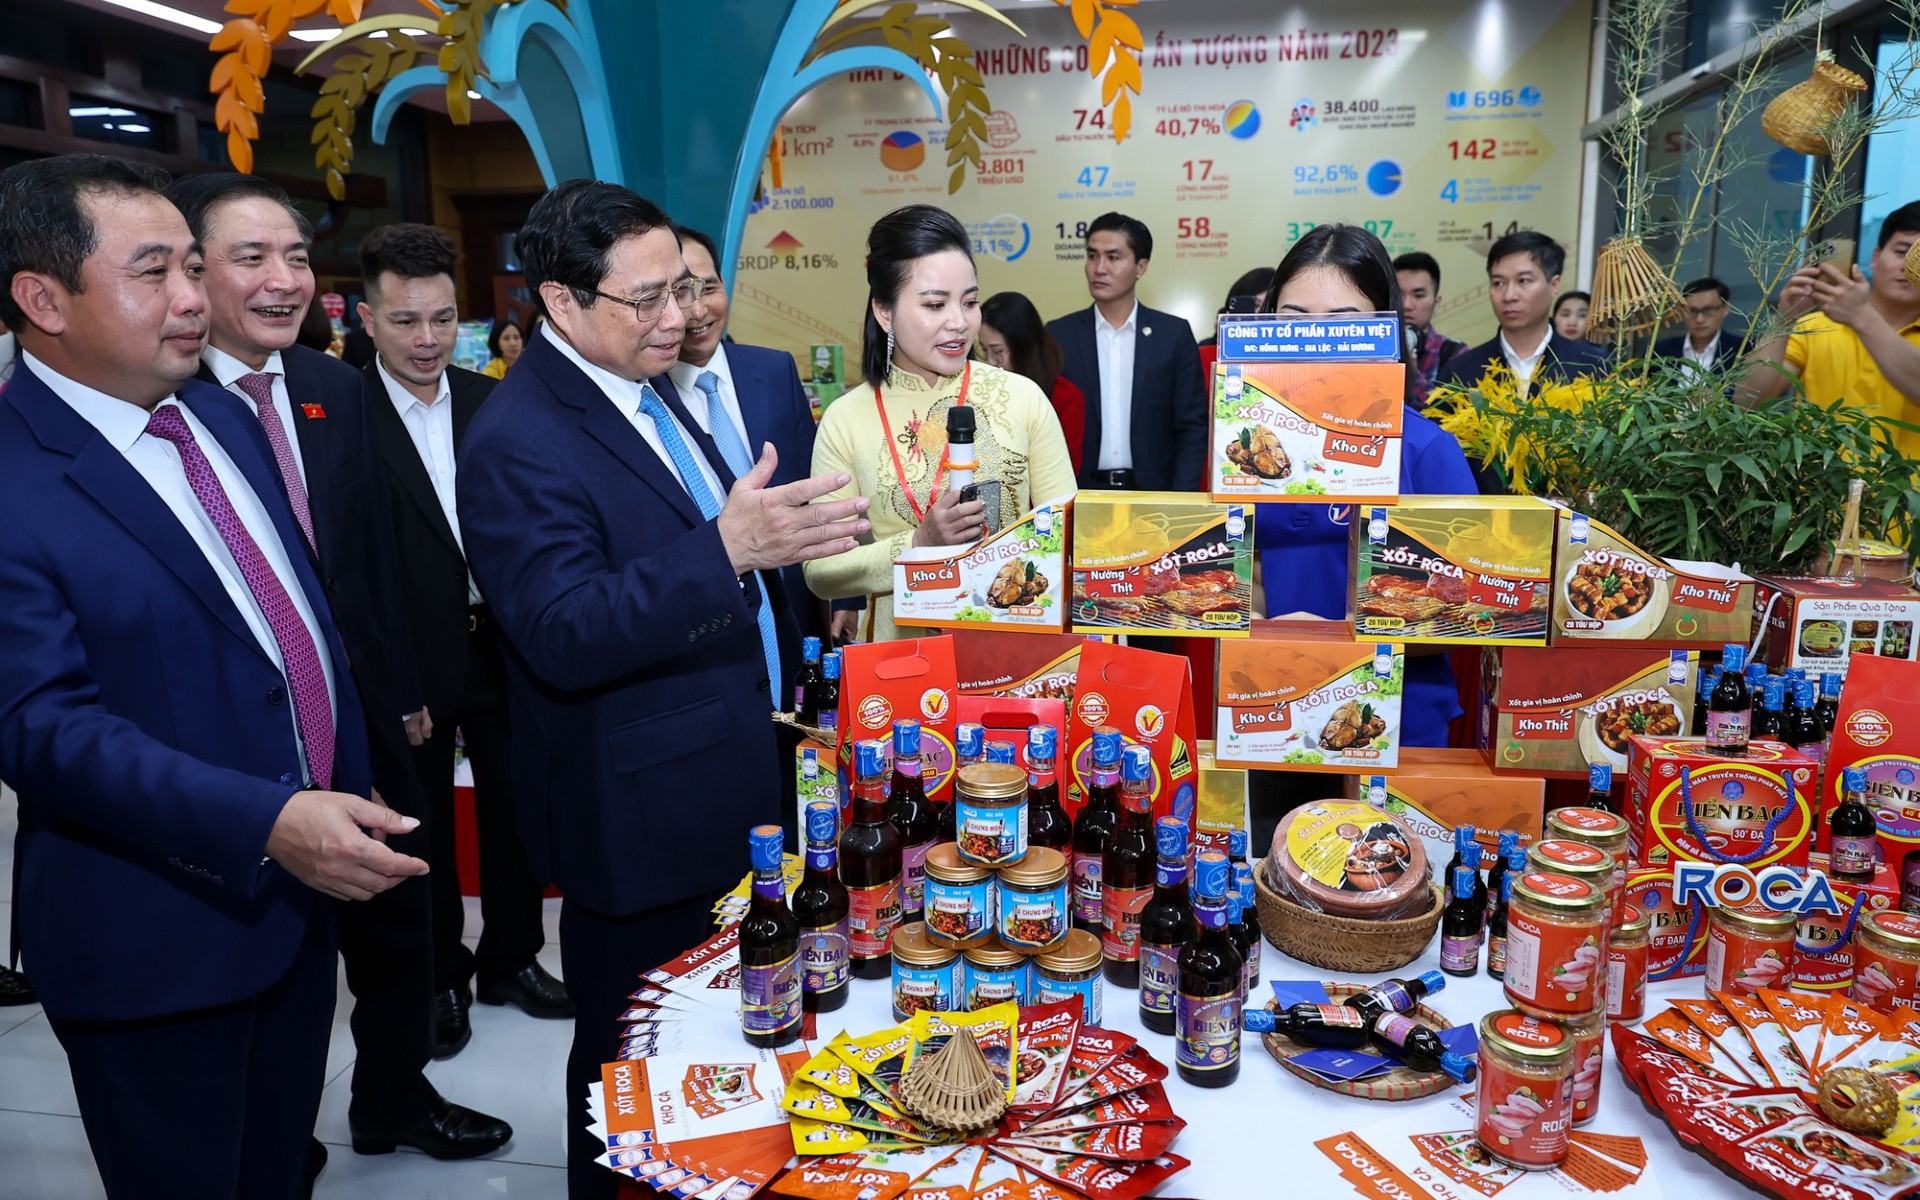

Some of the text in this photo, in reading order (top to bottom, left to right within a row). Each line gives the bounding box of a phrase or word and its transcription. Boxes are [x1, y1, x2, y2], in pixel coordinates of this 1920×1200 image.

[975, 44, 1051, 76] NHỮNG
[1061, 48, 1089, 73] CO
[1193, 36, 1268, 70] TƯỢNG
[1278, 28, 1329, 61] NĂM
[1341, 28, 1398, 57] 2023
[1323, 99, 1380, 115] 38.400
[1473, 89, 1514, 108] 696
[1073, 109, 1105, 130] 74
[1155, 117, 1221, 138] 40,7%
[1448, 138, 1497, 160] 142
[1077, 166, 1110, 187] 47
[1182, 160, 1214, 181] 17
[1293, 164, 1359, 184] 92,6%
[1440, 178, 1458, 204] 4
[772, 197, 834, 210] 2.100.000
[1177, 216, 1210, 239] 58
[785, 254, 838, 271] 8,16%
[1227, 322, 1392, 340] CÔNG TY CỔ PHẦN XUYÊN VIỆT
[1304, 343, 1317, 352] GIA
[1318, 342, 1331, 354] LỘC
[1237, 402, 1319, 436] XỐT ROCA
[1333, 415, 1346, 424] gia
[1346, 416, 1354, 426] vị
[1353, 417, 1372, 428] hoàn
[1331, 438, 1377, 457] Kho Cá
[964, 536, 1041, 570] XỐT ROCA
[1094, 556, 1104, 566] gia
[1105, 555, 1112, 564] vị
[1113, 551, 1130, 563] hoàn
[1150, 541, 1230, 576] XỐT ROCA
[1382, 546, 1465, 580] XỐT ROCA
[1481, 559, 1494, 570] gia
[1500, 563, 1520, 573] hoàn
[1583, 546, 1668, 581] XỐT ROCA
[912, 566, 954, 583] Kho Cá
[1090, 567, 1125, 583] Nướng
[1478, 573, 1516, 591] Nướng
[1111, 581, 1134, 595] Thịt
[1680, 584, 1732, 605] Kho Thịt
[1495, 592, 1519, 609] Thịt
[1860, 601, 1881, 612] Quà
[1884, 602, 1907, 613] Tặng
[961, 682, 971, 690] gia
[978, 678, 994, 688] hoàn
[1227, 692, 1240, 701] Xốt
[1240, 692, 1252, 702] gia
[1252, 691, 1259, 700] vị
[1259, 688, 1277, 699] hoàn
[1296, 680, 1379, 712] XỐT ROCA
[1508, 691, 1583, 708] Xốt gia vị hoàn chỉnh
[1583, 686, 1671, 719] XỐT ROCA
[863, 706, 885, 717] 100%
[1239, 710, 1285, 725] Kho Cá
[1519, 718, 1569, 734] Kho Thịt
[1853, 723, 1883, 731] 100%
[1675, 860, 1843, 916] ROCA
[1517, 919, 1542, 935] ROCA
[682, 946, 711, 965] XỐT
[1824, 953, 1850, 967] ĐẠM
[685, 964, 710, 980] KHO
[1032, 1011, 1073, 1031] ROCA
[1790, 1006, 1822, 1022] XỐT
[1050, 1032, 1069, 1043] Thịt
[1505, 1027, 1550, 1043] ROCA
[860, 1043, 886, 1064] XỐT
[615, 1064, 638, 1116] XỐT ROCA
[654, 1089, 675, 1125] KHO CÁ
[1333, 1140, 1380, 1178] ROCA
[1410, 1166, 1431, 1182] CÁ
[1744, 1151, 1802, 1187] ROCA
[802, 1171, 892, 1188] ROCA XỐT
